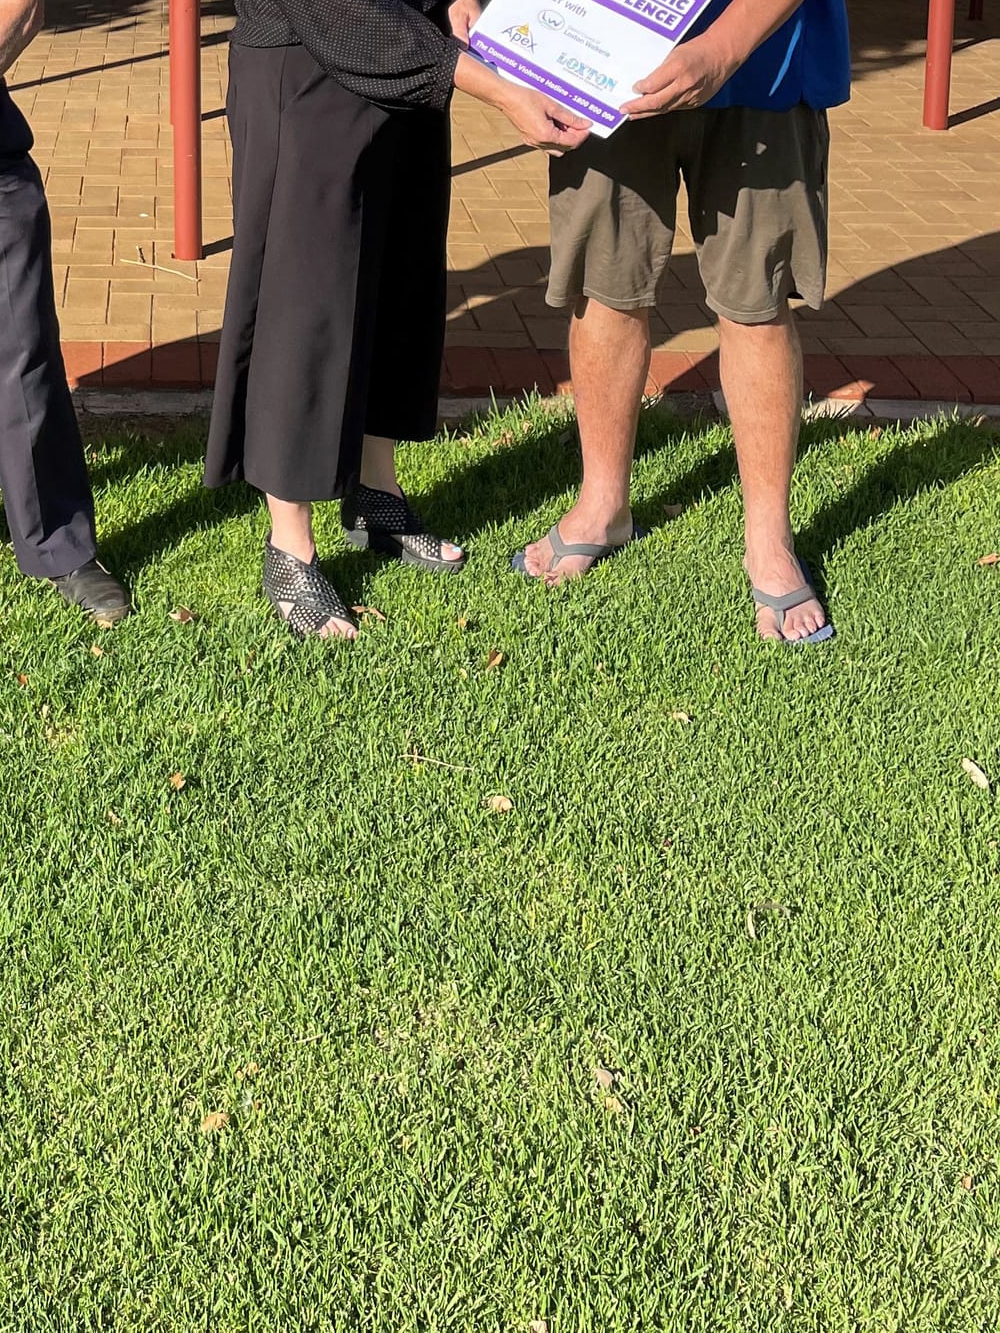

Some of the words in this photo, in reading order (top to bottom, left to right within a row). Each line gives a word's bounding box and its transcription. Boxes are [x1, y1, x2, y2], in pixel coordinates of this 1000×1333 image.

[502, 27, 538, 53] Apex
[563, 28, 585, 45] Loxton
[475, 39, 487, 51] The
[487, 47, 518, 68] Domestic
[517, 64, 545, 84] Violence
[545, 79, 569, 97] Hotline
[556, 52, 618, 93] LOXTON
